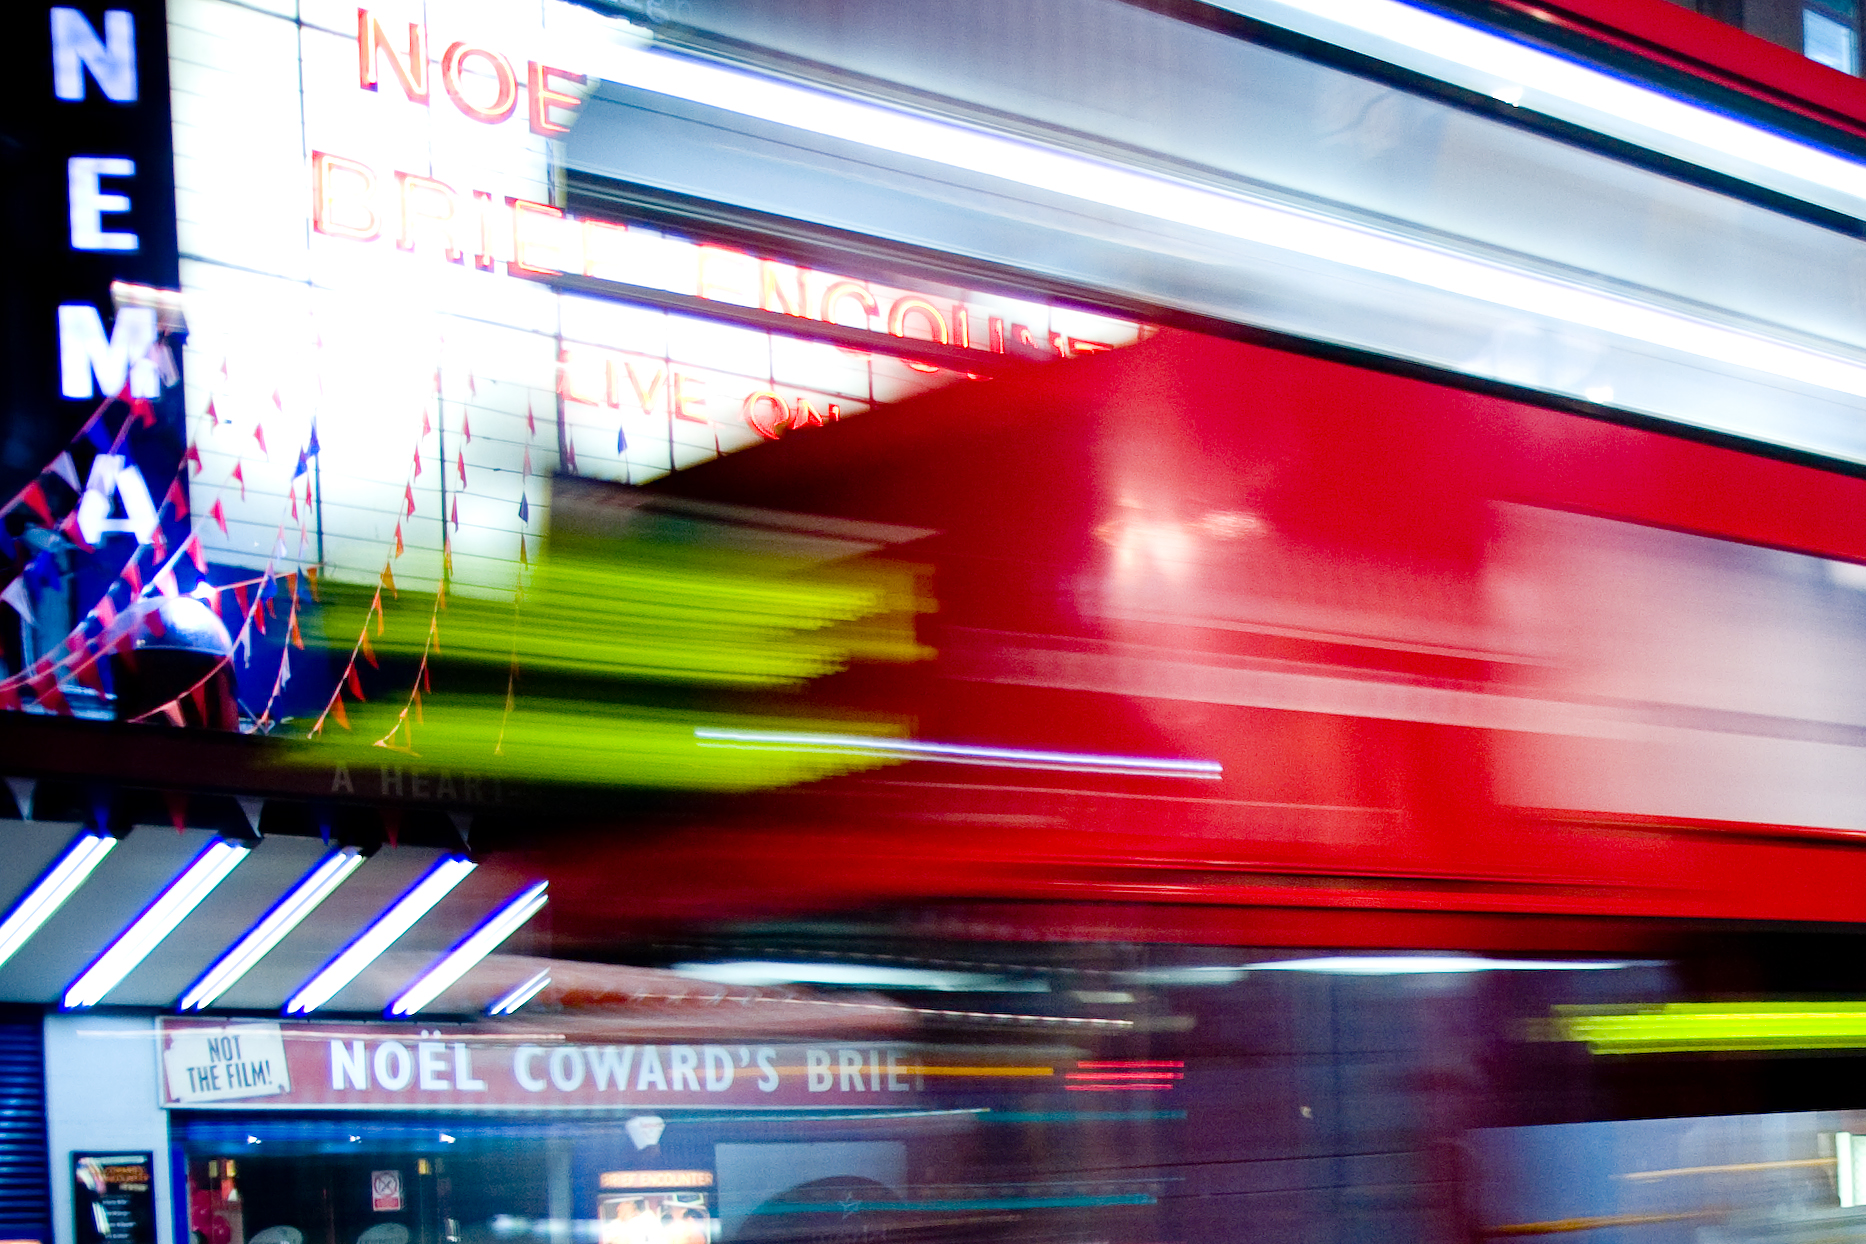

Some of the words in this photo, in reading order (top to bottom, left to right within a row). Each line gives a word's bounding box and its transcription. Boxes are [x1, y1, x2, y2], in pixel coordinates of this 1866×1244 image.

[207, 1034, 241, 1063] NOT
[330, 1029, 488, 1092] NOËL
[514, 1043, 782, 1094] COWARD'S
[187, 1064, 220, 1094] THE
[225, 1059, 272, 1089] FILM!
